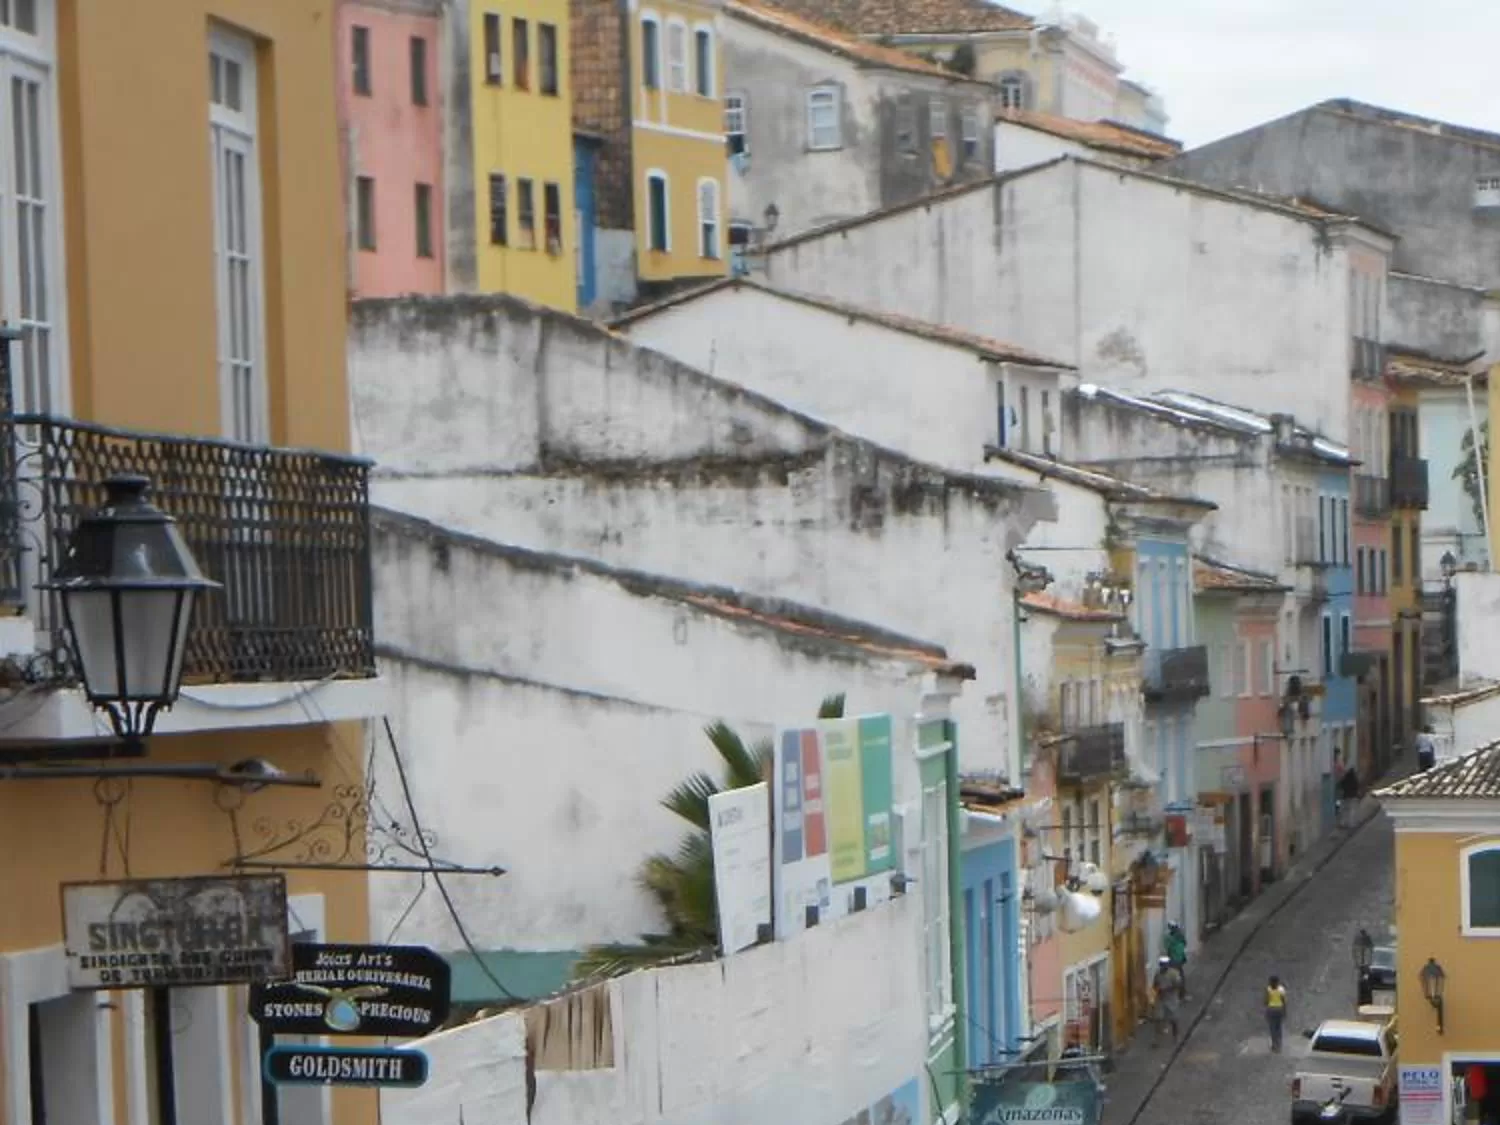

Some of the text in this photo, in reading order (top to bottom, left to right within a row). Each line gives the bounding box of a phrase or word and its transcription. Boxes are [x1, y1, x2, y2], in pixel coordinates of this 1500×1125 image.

[264, 1003, 323, 1018] STONES
[361, 1001, 431, 1024] PRECIOUS
[289, 1055, 403, 1079] GOLDSMITH
